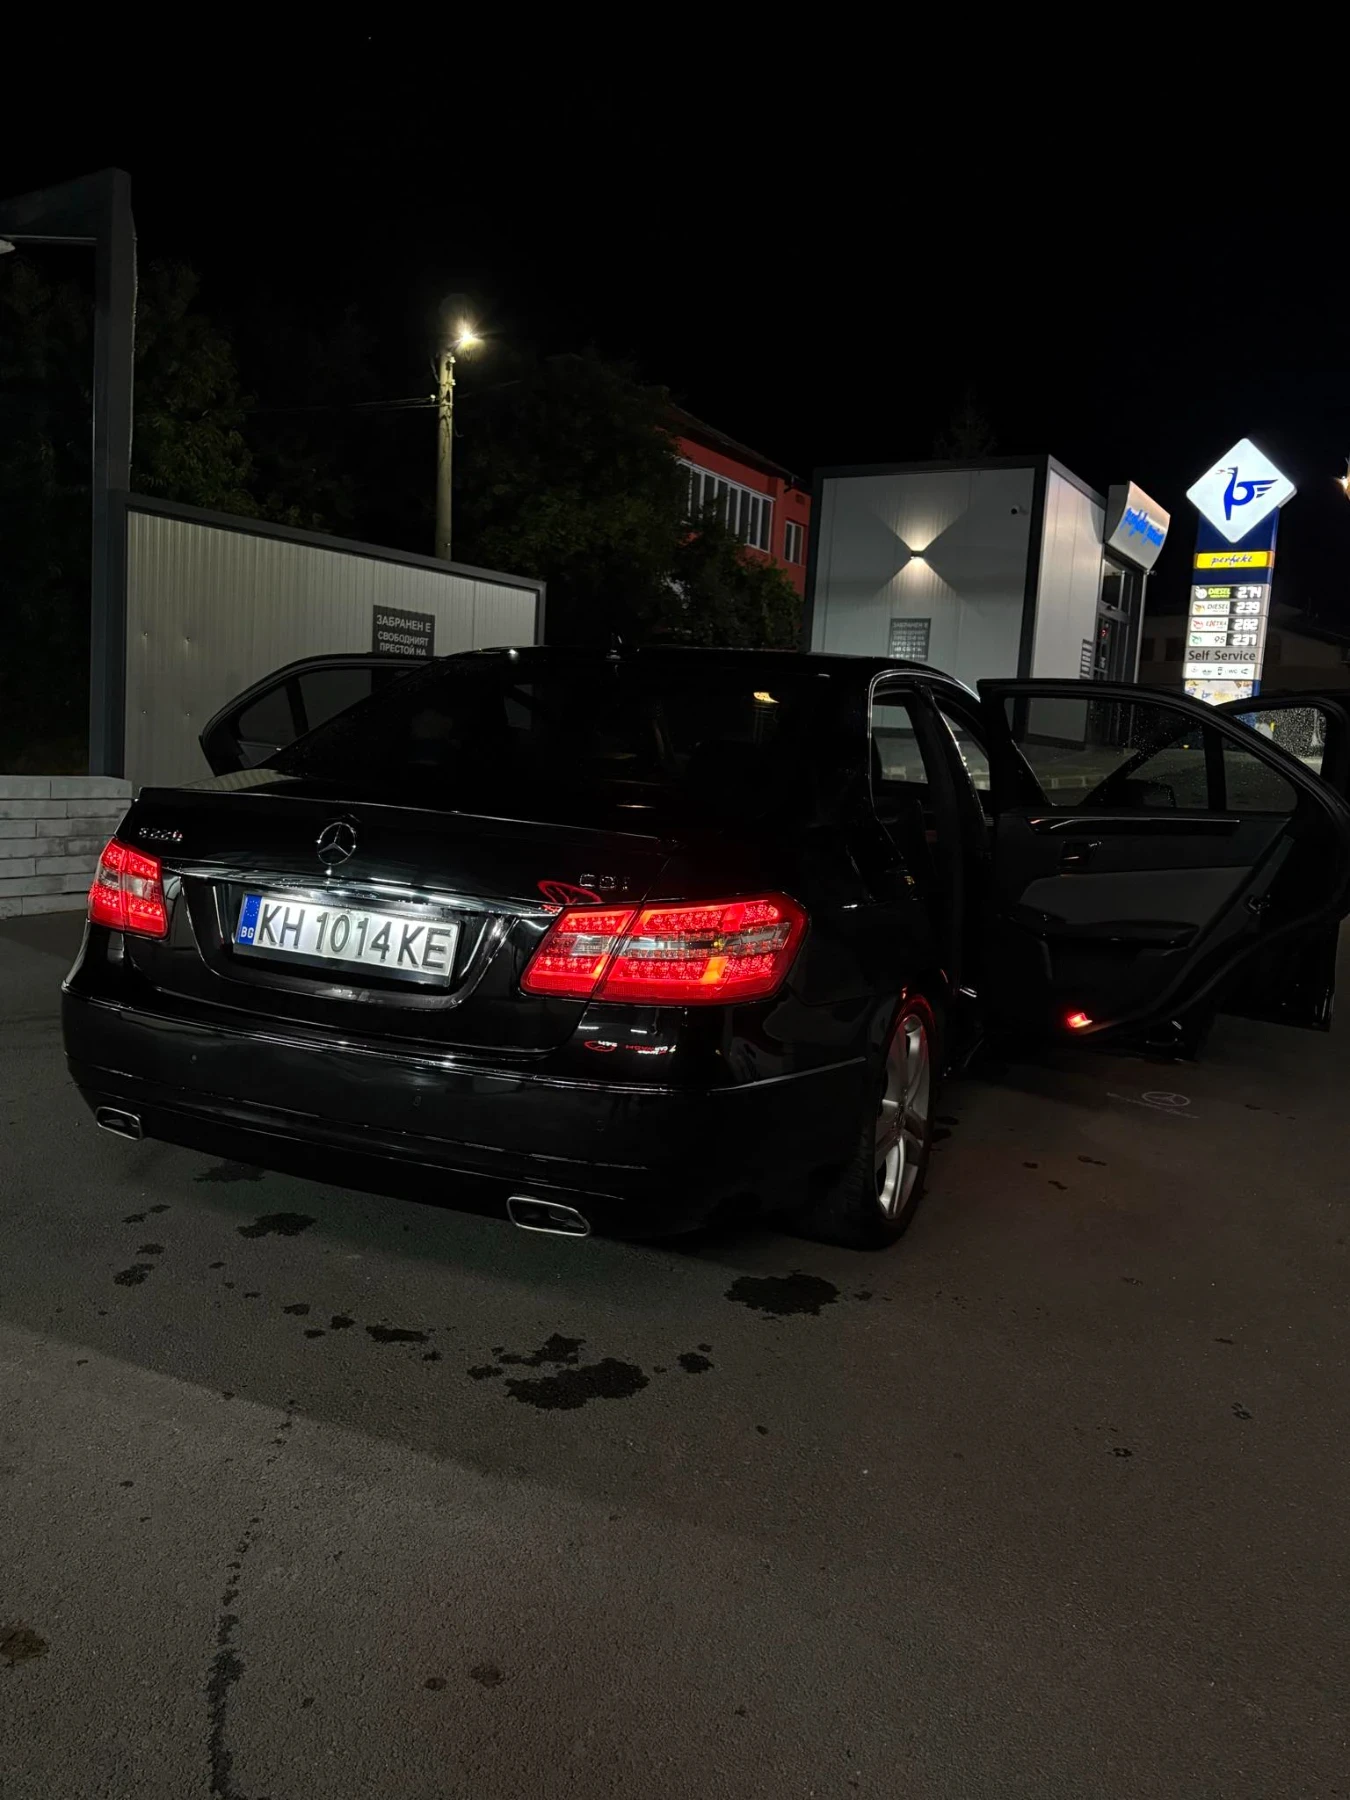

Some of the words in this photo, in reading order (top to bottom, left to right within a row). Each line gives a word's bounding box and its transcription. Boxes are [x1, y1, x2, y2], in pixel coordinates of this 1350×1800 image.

[1236, 586, 1262, 599] 274
[1235, 601, 1260, 614] 239
[376, 614, 423, 631] ЗАБРАНЕН
[425, 622, 432, 633] Е
[377, 631, 429, 646] СВОБОДНИЯТ
[1214, 636, 1225, 644] 95
[380, 642, 415, 655] ПРЕСТОЙ
[416, 648, 427, 656] НА
[1188, 650, 1209, 661] Self
[1214, 650, 1256, 661] Service
[240, 926, 254, 939] BG
[315, 911, 392, 962] 1014
[397, 923, 452, 970] KE
